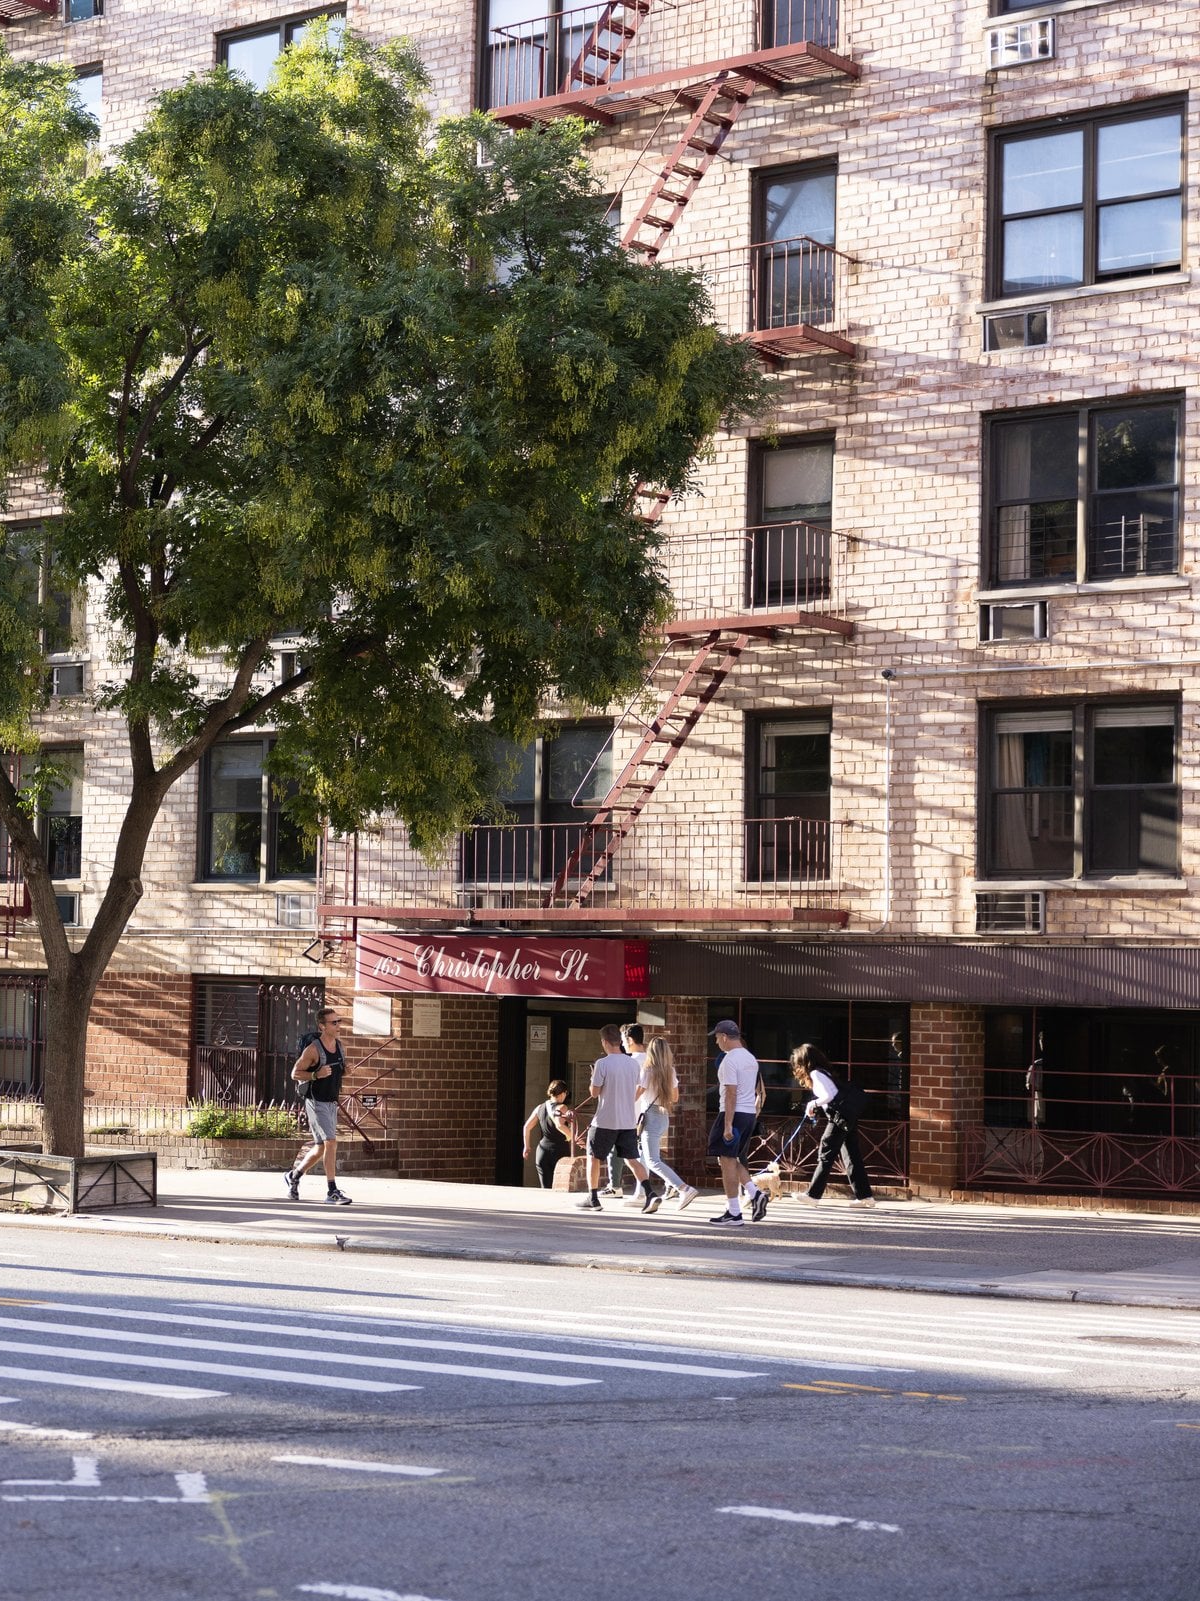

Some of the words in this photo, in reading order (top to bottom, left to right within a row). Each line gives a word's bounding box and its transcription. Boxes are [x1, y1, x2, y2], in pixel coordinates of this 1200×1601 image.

[372, 956, 402, 976] 165
[413, 944, 541, 992] Christopher
[555, 948, 589, 982] St.
